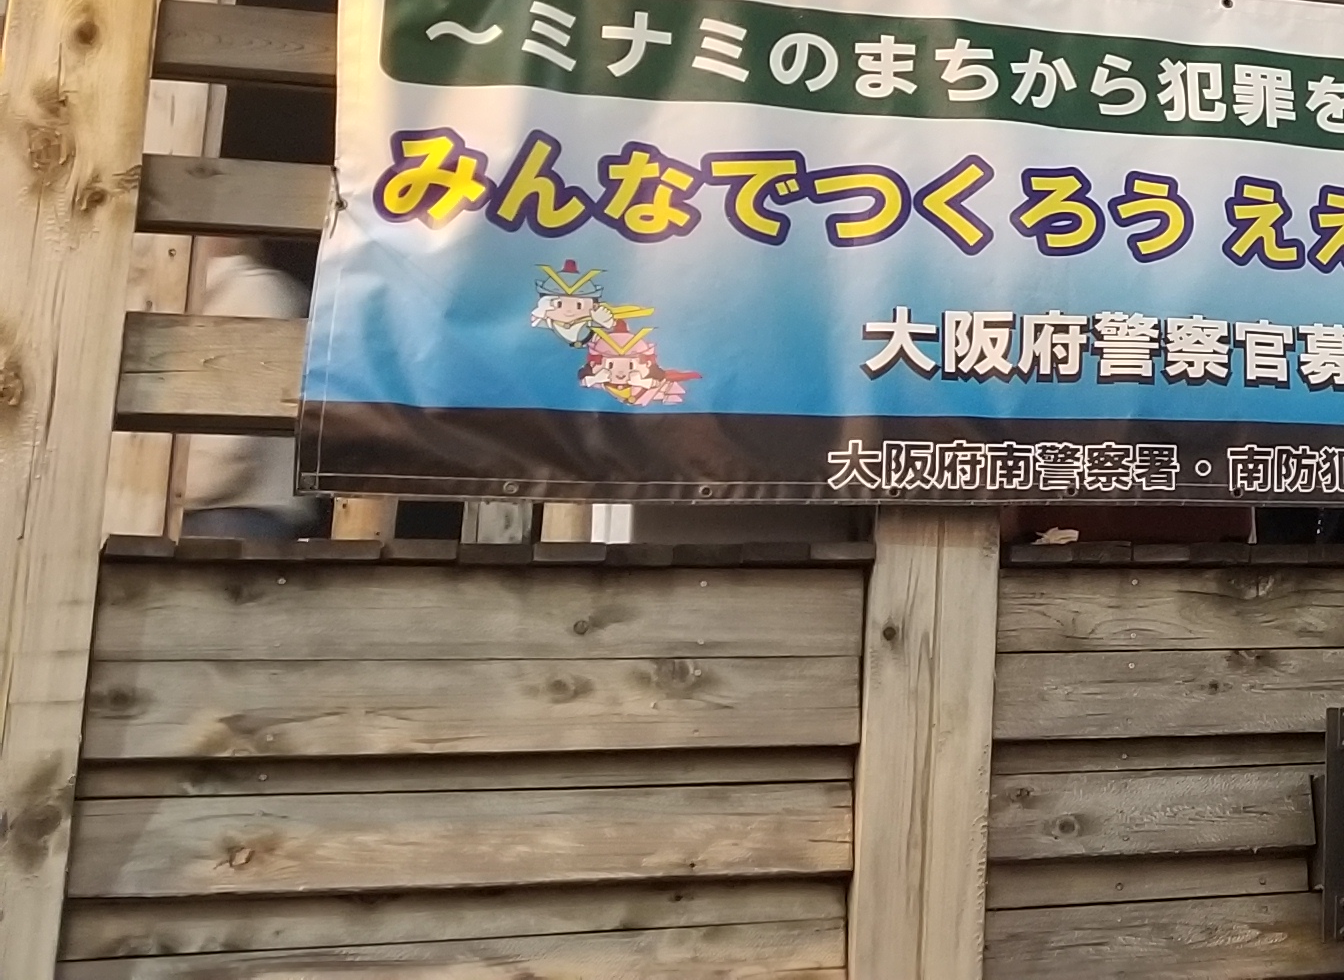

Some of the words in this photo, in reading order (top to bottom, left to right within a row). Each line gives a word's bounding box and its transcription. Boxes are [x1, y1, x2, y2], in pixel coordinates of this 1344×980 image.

[374, 127, 1194, 262] みんなでつくろう
